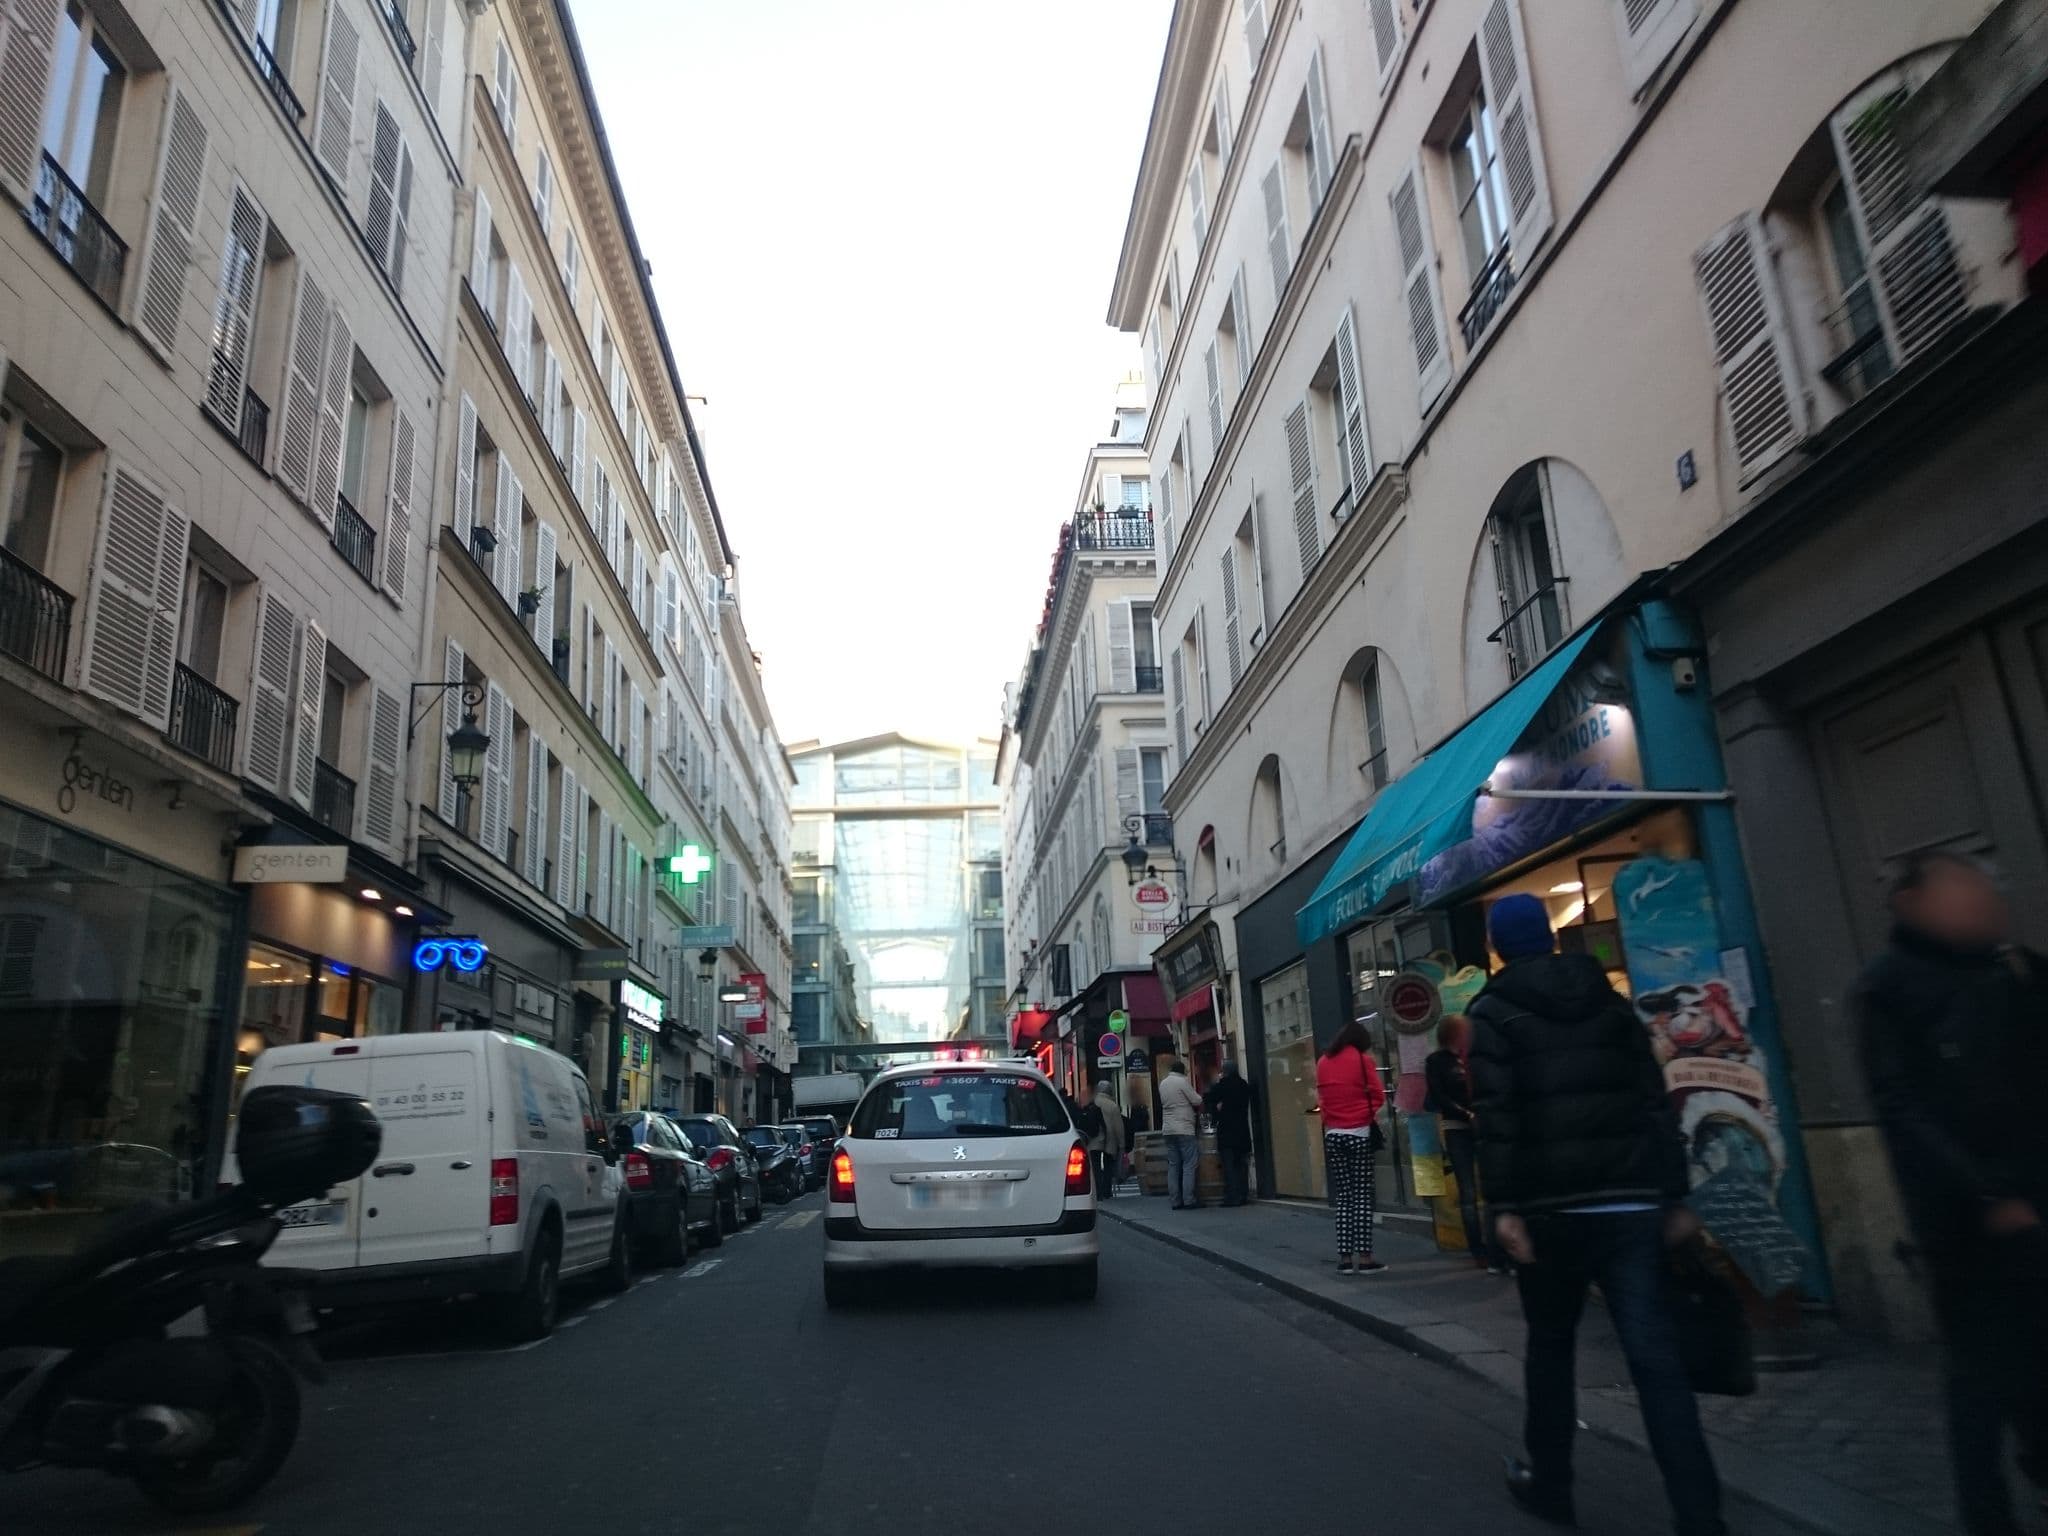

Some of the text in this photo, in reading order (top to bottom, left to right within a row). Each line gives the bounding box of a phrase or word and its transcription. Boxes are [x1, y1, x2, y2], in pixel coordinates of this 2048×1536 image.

[58, 756, 134, 814] genten
[249, 852, 332, 880] genten
[1134, 921, 1144, 931] AU
[895, 1079, 920, 1088] TAXIS
[951, 1077, 979, 1085] 3607
[990, 1078, 1016, 1086] TAXIS
[431, 1092, 446, 1102] 55
[450, 1090, 465, 1100] 22
